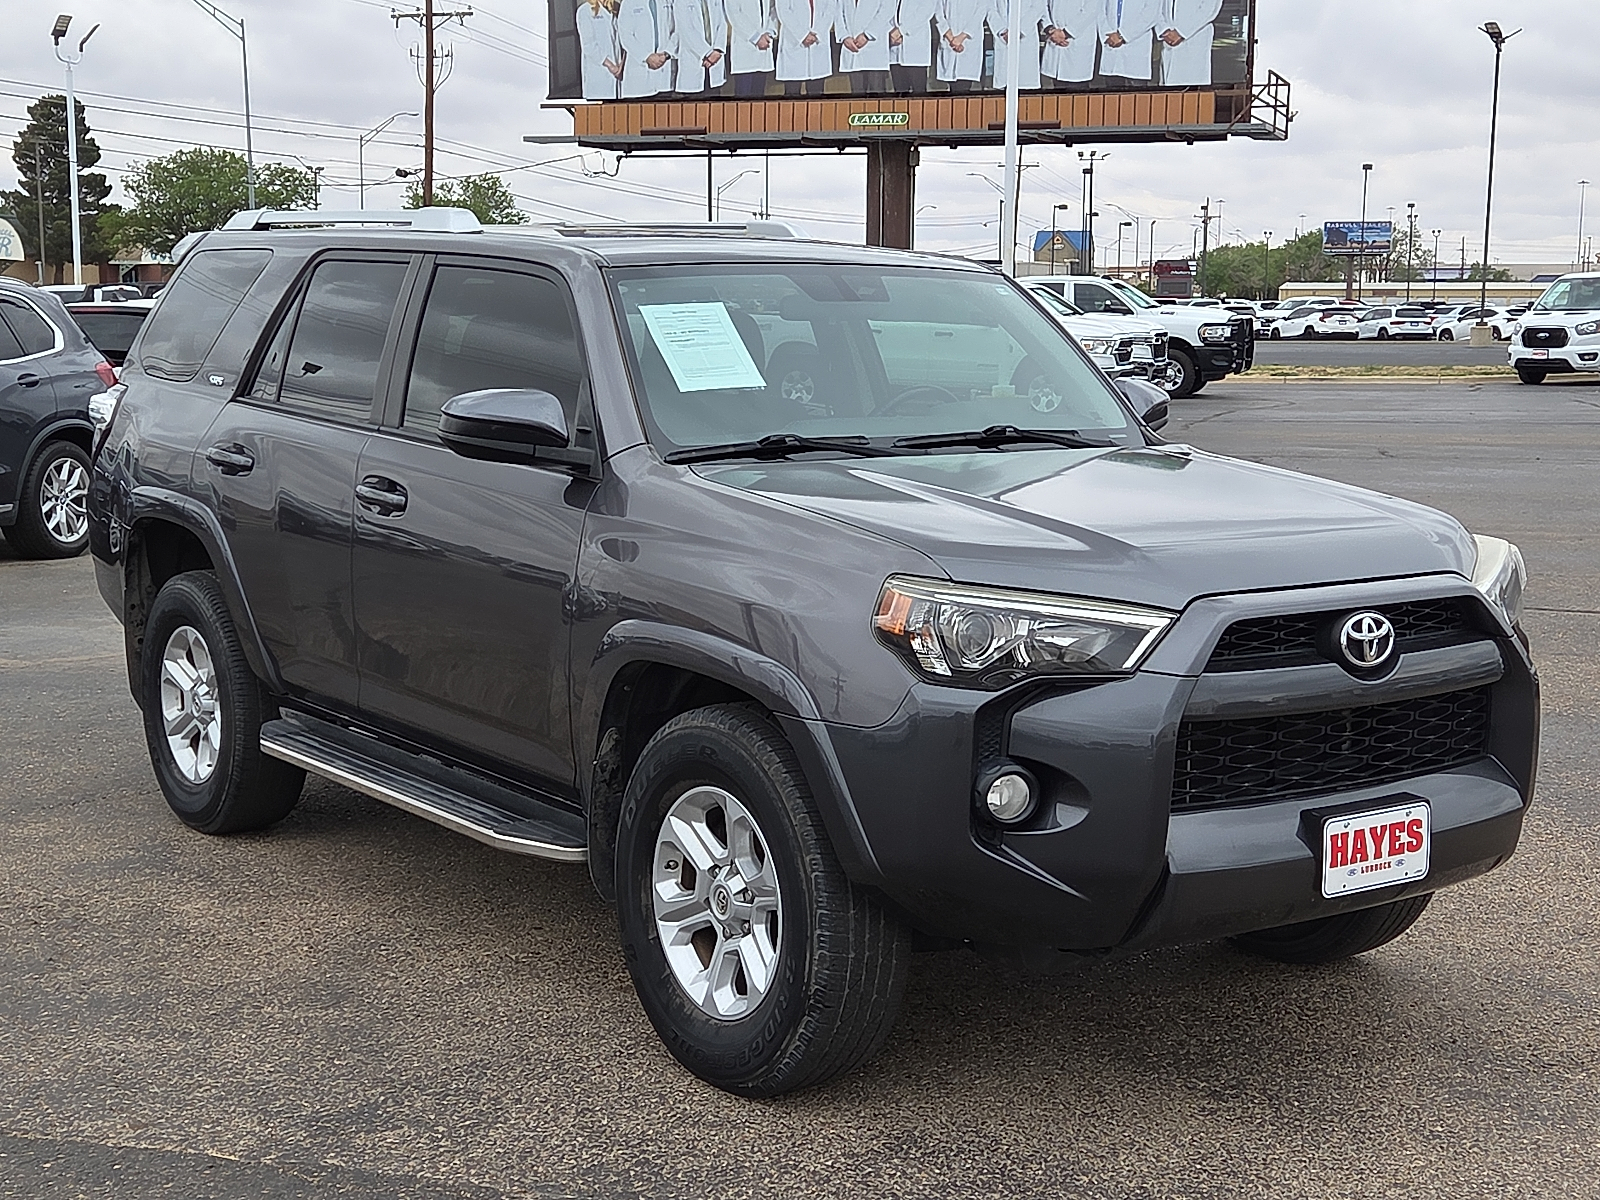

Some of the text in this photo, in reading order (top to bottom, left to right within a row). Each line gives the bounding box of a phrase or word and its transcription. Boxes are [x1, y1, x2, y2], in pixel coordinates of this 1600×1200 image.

[853, 114, 904, 125] LAMAR
[1329, 818, 1424, 869] HAYES
[1360, 860, 1392, 875] LUBBOCK
